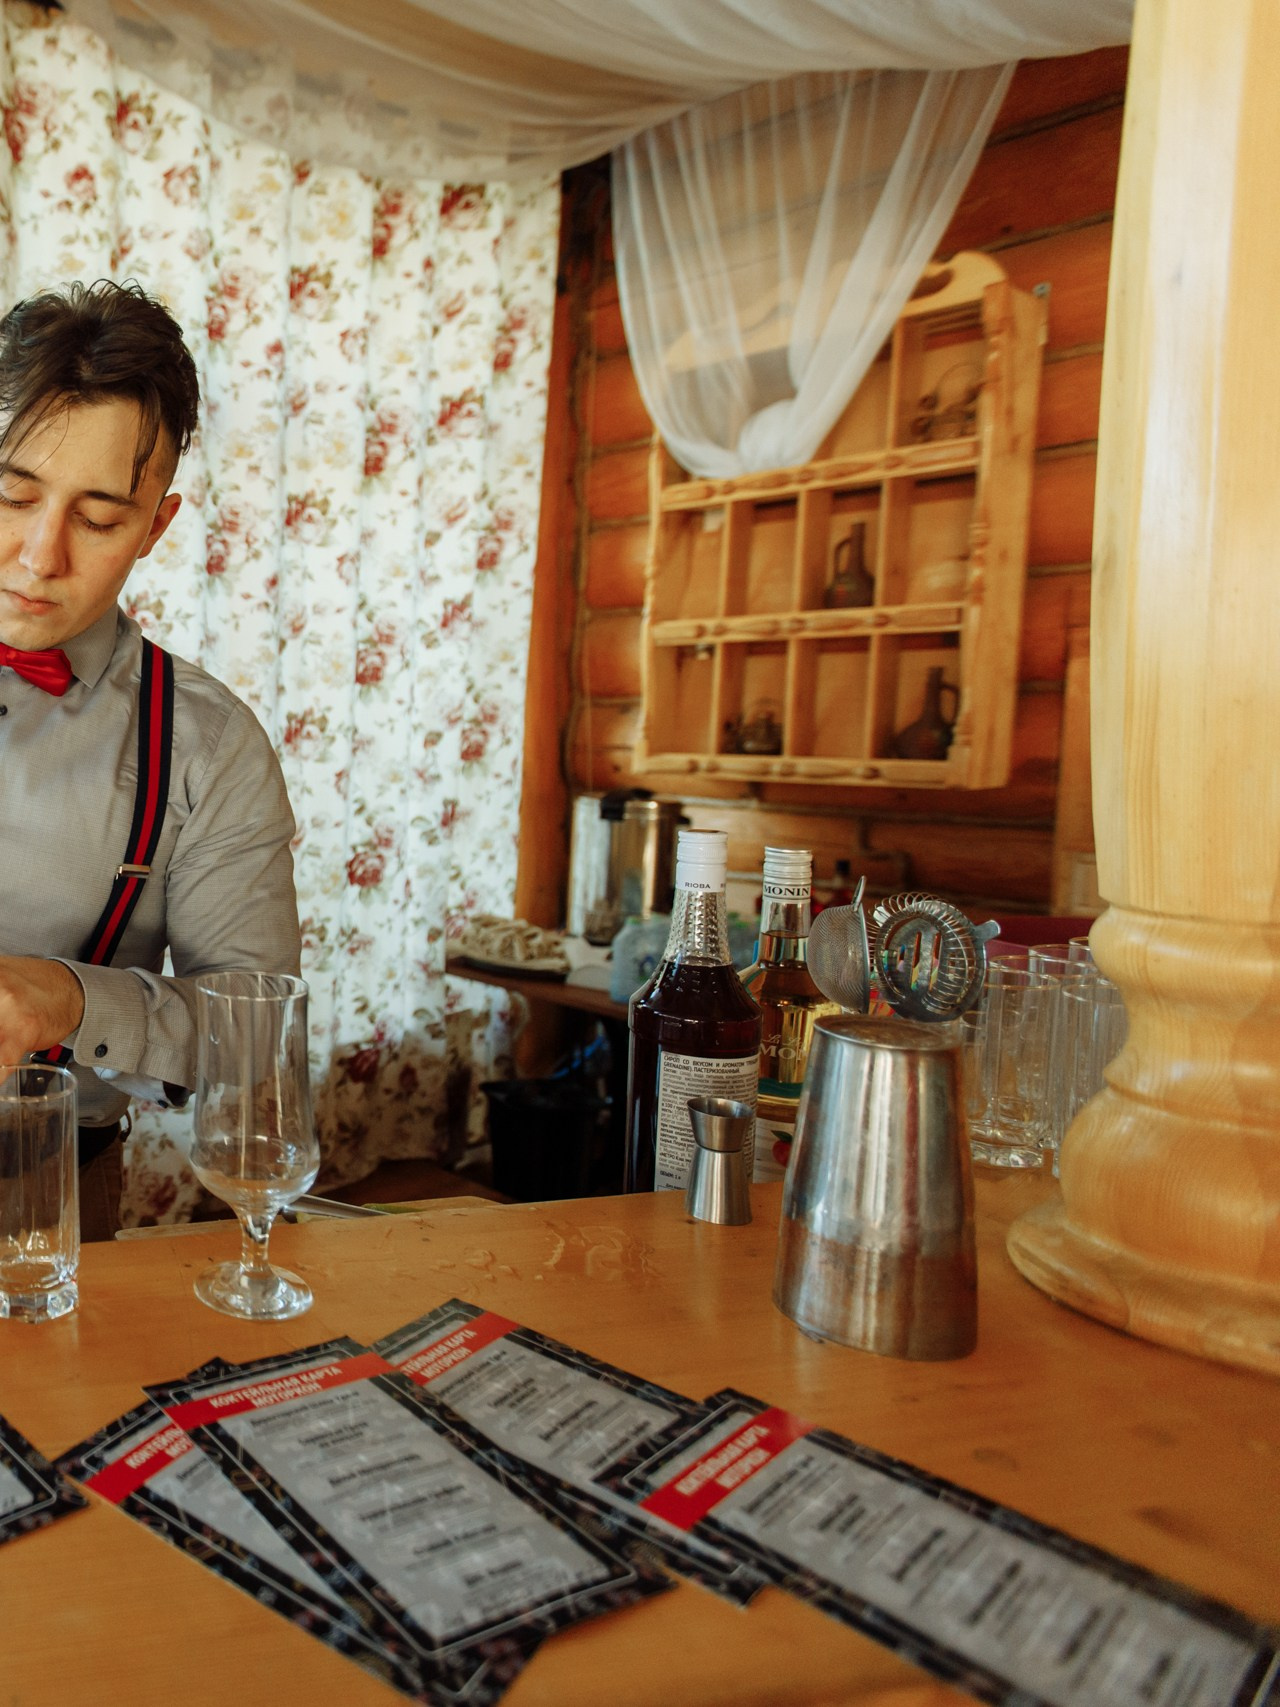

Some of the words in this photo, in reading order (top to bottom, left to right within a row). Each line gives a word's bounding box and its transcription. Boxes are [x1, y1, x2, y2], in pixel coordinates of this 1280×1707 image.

[684, 881, 711, 889] RIOBA
[763, 884, 810, 897] MONIN
[209, 1376, 301, 1408] КОКТЕЙЛЬНАЯ
[299, 1366, 343, 1384] КАРТА
